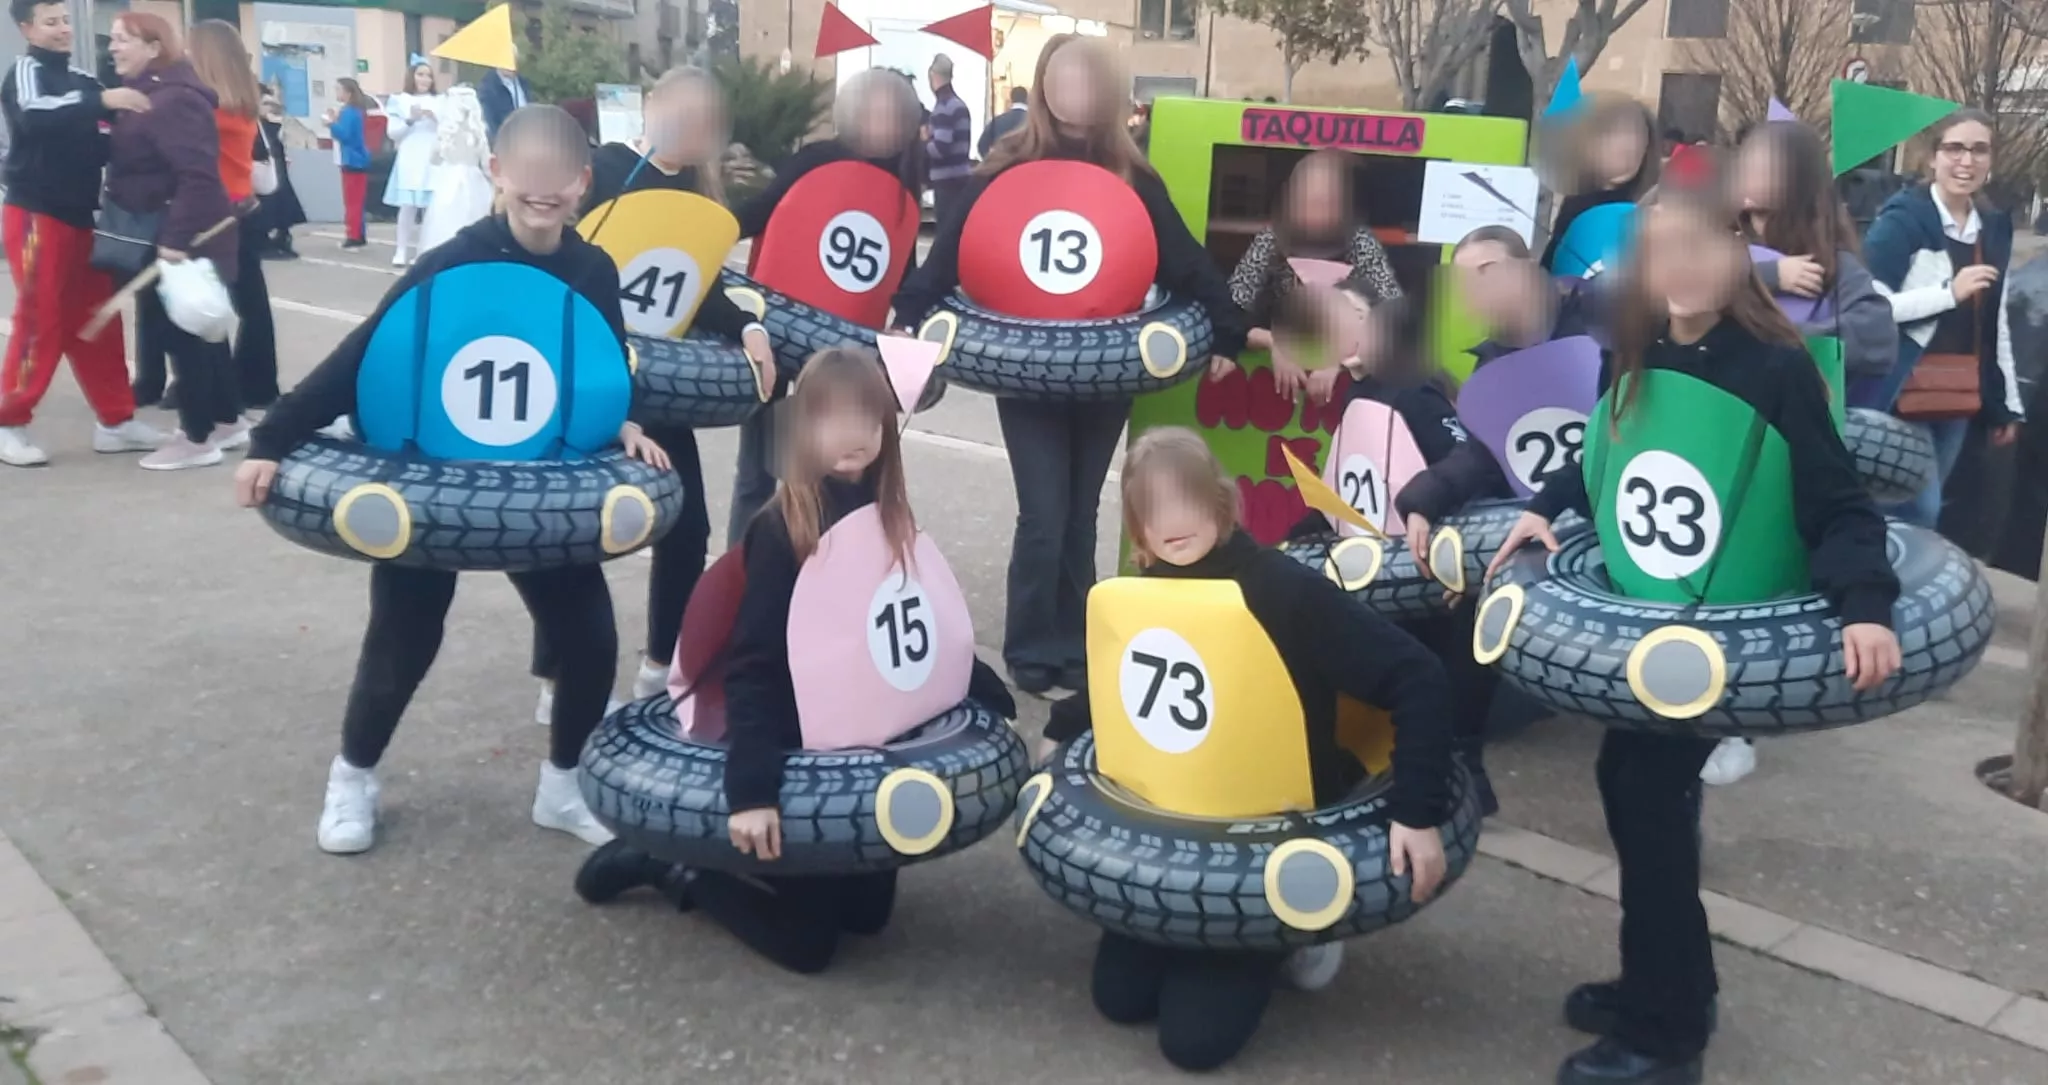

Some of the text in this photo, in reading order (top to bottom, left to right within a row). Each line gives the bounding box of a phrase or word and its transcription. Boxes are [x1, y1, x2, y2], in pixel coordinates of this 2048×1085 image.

[1244, 111, 1420, 148] TAQUILLA
[826, 226, 882, 282] 95
[1030, 228, 1087, 275] 13
[617, 266, 687, 317] 41
[464, 360, 529, 421] 11
[1516, 421, 1585, 483] 28
[1344, 469, 1377, 514] 21
[1622, 477, 1706, 556] 33
[875, 596, 928, 668] 15
[1131, 650, 1208, 730] 73
